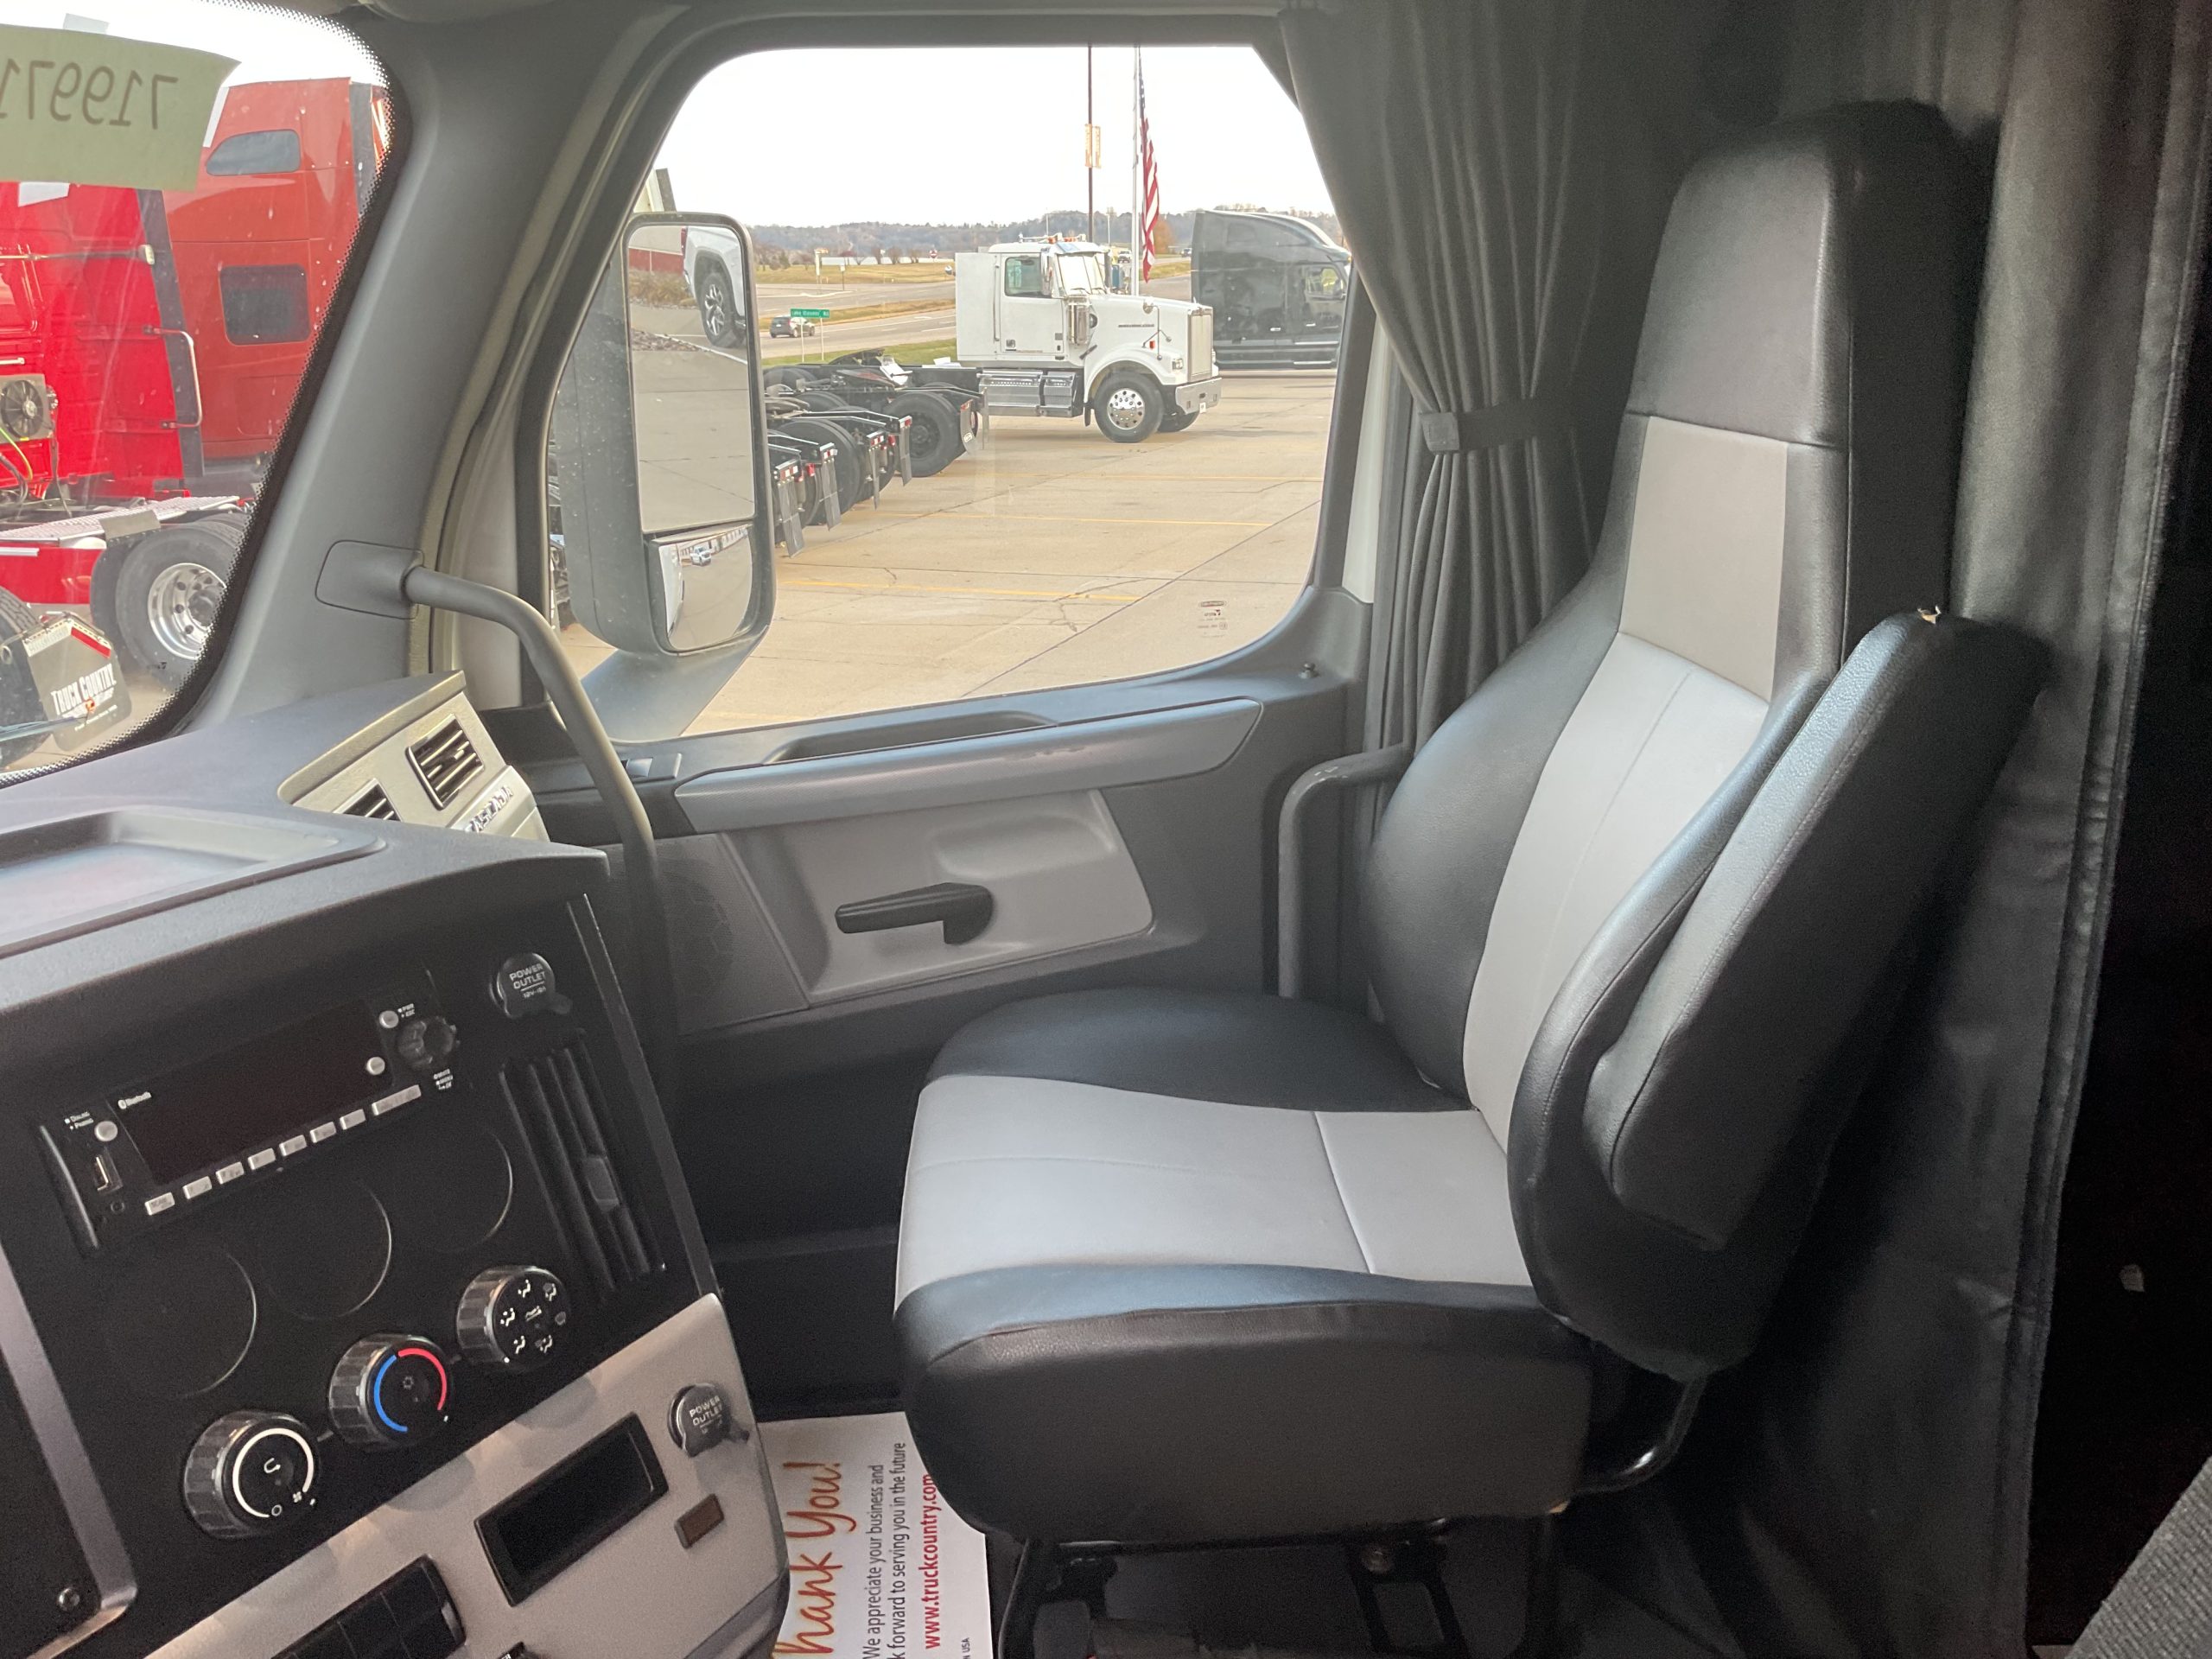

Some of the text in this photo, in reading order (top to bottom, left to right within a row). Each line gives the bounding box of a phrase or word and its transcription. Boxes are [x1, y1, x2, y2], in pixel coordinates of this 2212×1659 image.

[50, 663, 117, 715] TRUCK COUNTRY
[509, 963, 543, 982] POWER
[513, 971, 545, 989] OUTLET
[689, 1395, 720, 1418] POWER
[692, 1402, 722, 1426] OUTLET
[889, 1442, 906, 1474] future
[889, 1476, 906, 1494] the
[782, 1461, 857, 1538] You!
[889, 1497, 906, 1507] in
[893, 1510, 910, 1531] you
[862, 1465, 887, 1659] We appreciate your business and
[888, 1534, 910, 1577] serving
[918, 1473, 942, 1649] www.truckcountry.com
[890, 1580, 906, 1593] to
[887, 1597, 906, 1649] forward
[962, 1637, 970, 1653] USA
